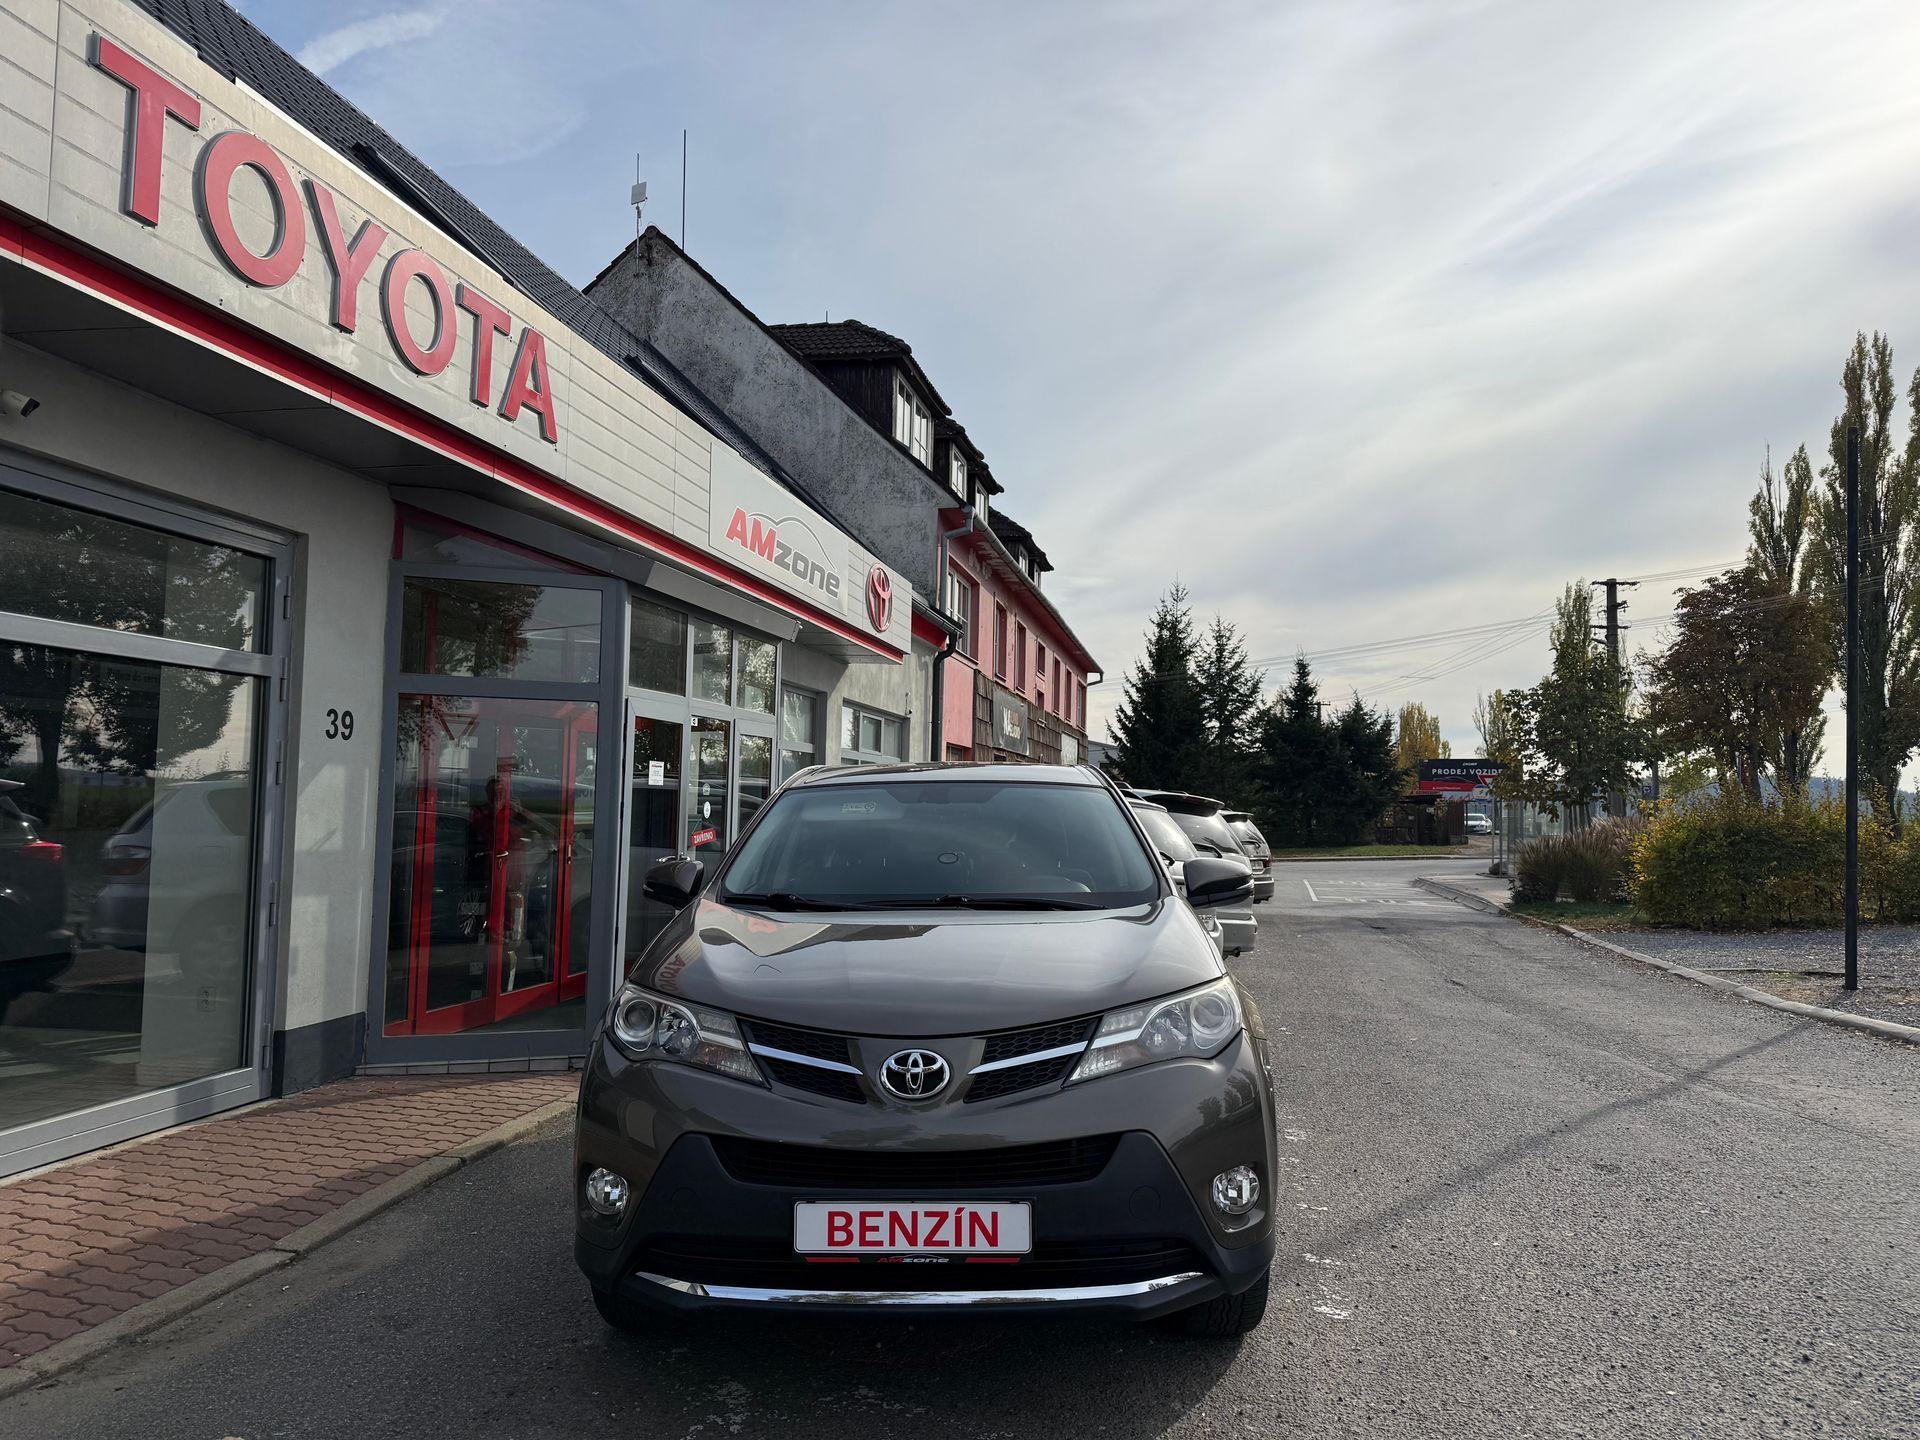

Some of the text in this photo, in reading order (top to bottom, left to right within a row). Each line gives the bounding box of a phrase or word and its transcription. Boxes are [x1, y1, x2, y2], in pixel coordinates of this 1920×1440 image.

[94, 33, 558, 444] TOYOTA
[725, 507, 841, 598] AMzone
[325, 708, 354, 741] 39
[827, 1207, 999, 1248] BENZÍN
